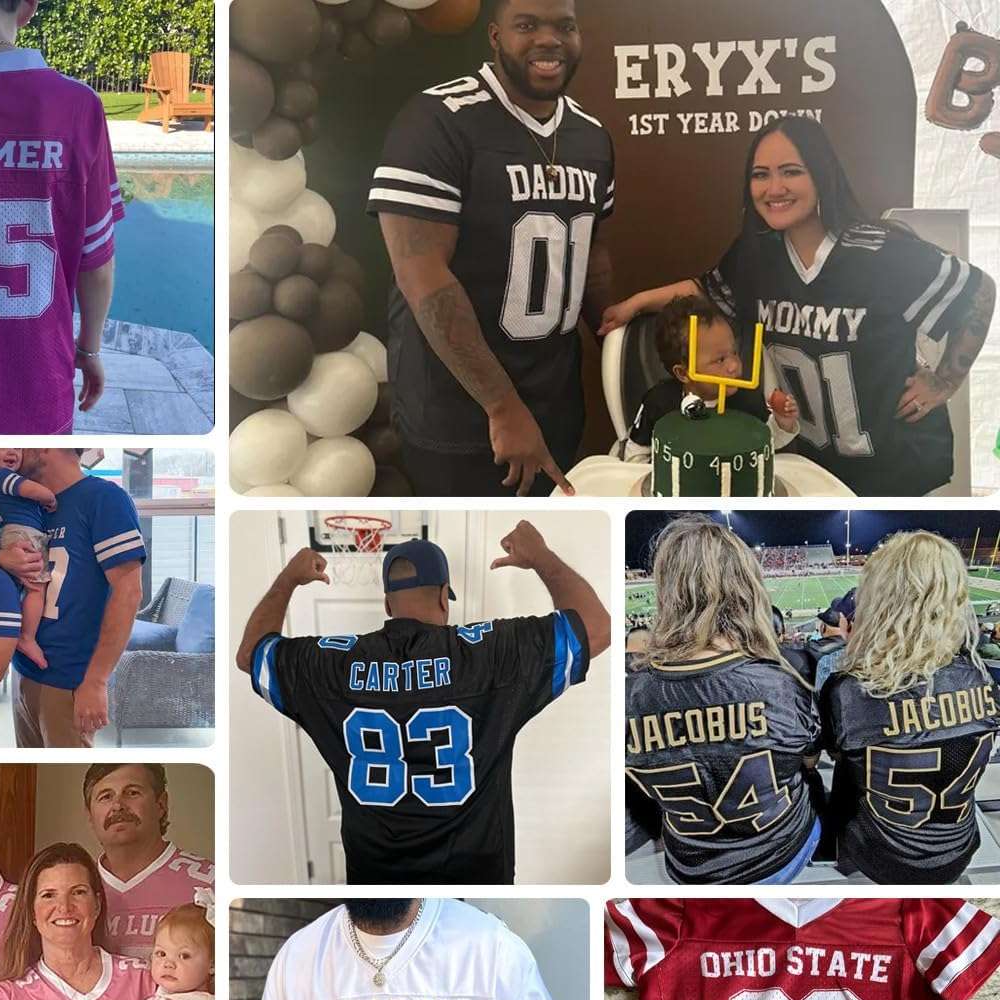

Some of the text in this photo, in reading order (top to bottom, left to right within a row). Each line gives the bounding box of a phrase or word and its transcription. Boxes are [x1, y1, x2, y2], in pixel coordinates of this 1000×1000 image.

[614, 35, 837, 99] ERYX'S
[628, 113, 669, 135] 1ST
[676, 111, 741, 134] YEAR
[506, 164, 598, 204] DADDY
[500, 211, 596, 341] 01
[757, 299, 868, 342] MOMMY
[763, 342, 876, 457] 01
[349, 657, 452, 692] CARTER
[627, 701, 768, 753] JACOBUS
[883, 684, 998, 737] JACOBUS
[343, 705, 477, 807] 83
[626, 750, 793, 836] 54
[700, 946, 893, 984] OHIO STATE
